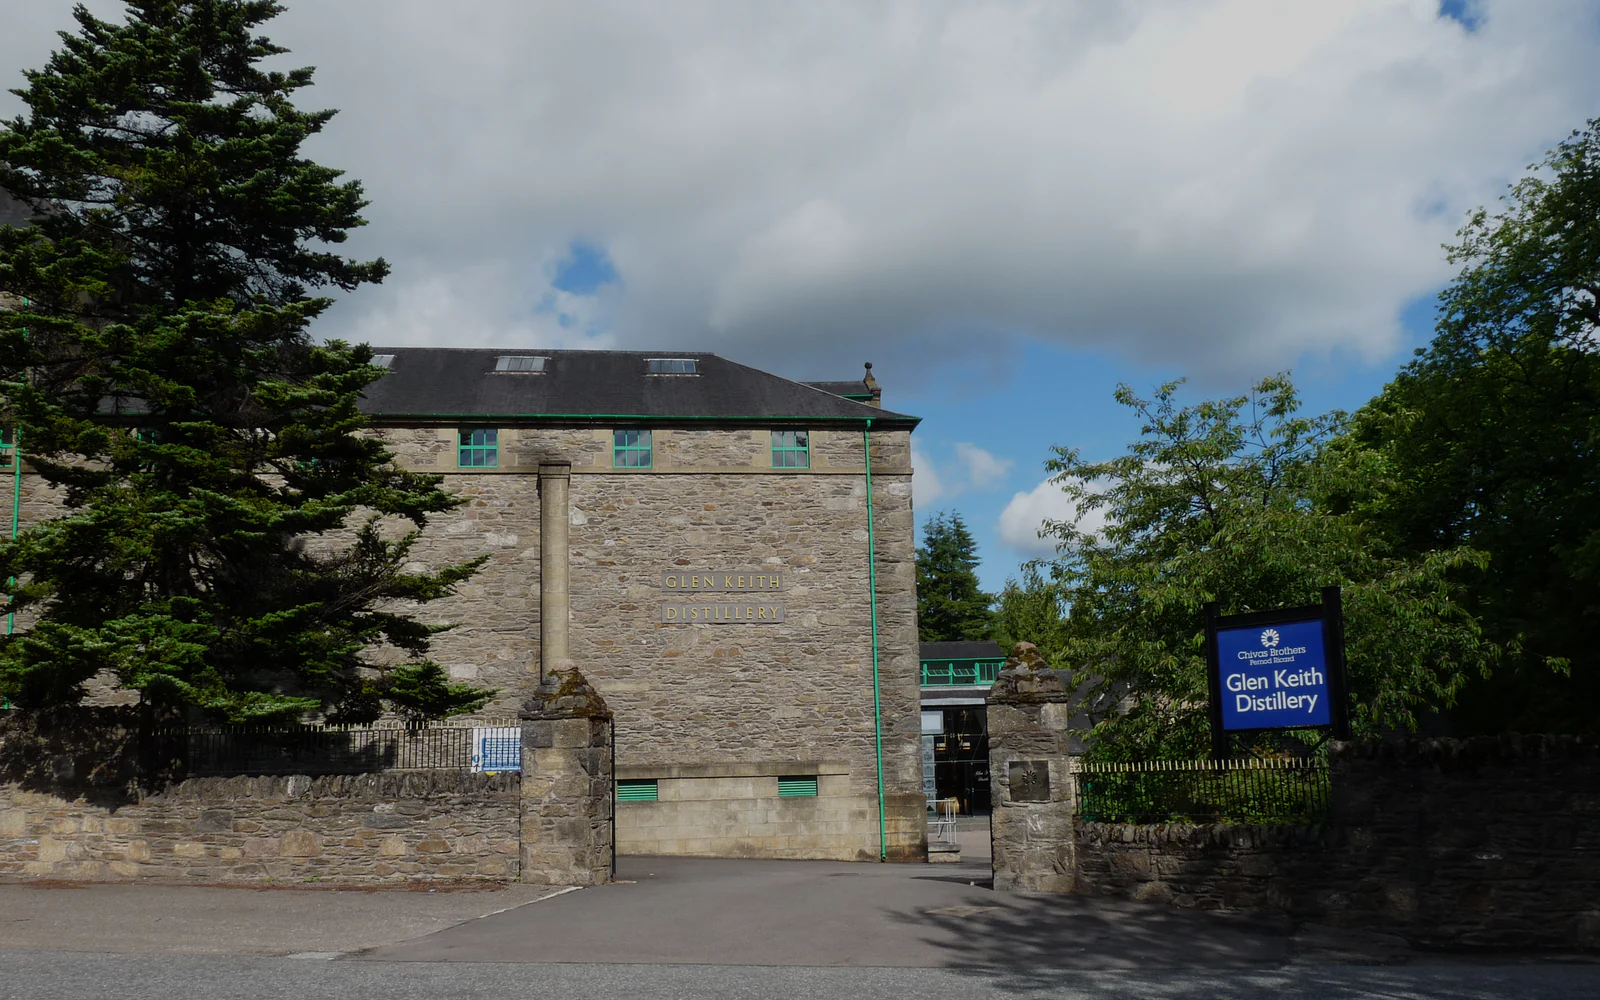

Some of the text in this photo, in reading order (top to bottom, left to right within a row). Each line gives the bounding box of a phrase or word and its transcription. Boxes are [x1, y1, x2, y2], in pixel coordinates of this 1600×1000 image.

[665, 575, 780, 588] GLEN KEITH
[666, 606, 780, 619] DISTILLERY
[1237, 646, 1306, 660] Chivas Brothers
[1226, 667, 1324, 692] Glen Keith
[1236, 691, 1318, 714] Distillery
